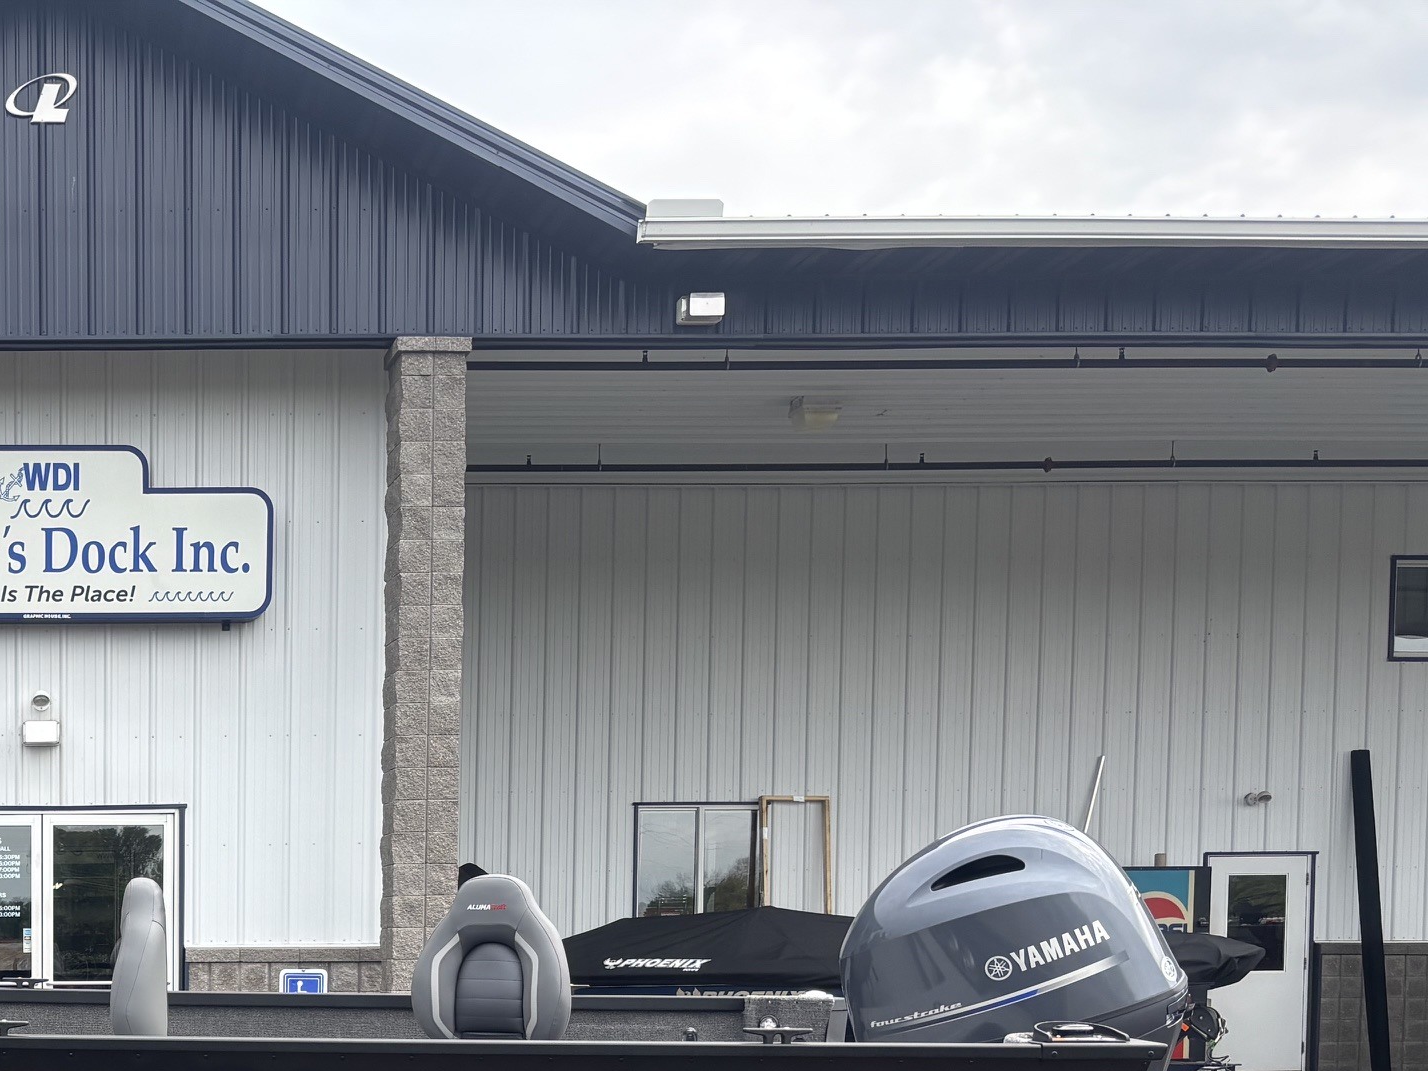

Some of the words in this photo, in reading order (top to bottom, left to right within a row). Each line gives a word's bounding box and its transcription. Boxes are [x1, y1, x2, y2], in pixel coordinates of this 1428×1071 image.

[23, 462, 81, 492] WDI
[40, 525, 158, 574] Dock
[171, 526, 251, 574] Inc.
[0, 585, 18, 603] Is
[24, 585, 64, 603] The
[70, 585, 137, 603] Place!
[1009, 919, 1111, 972] YAMAHA
[618, 958, 712, 968] PHOENIX
